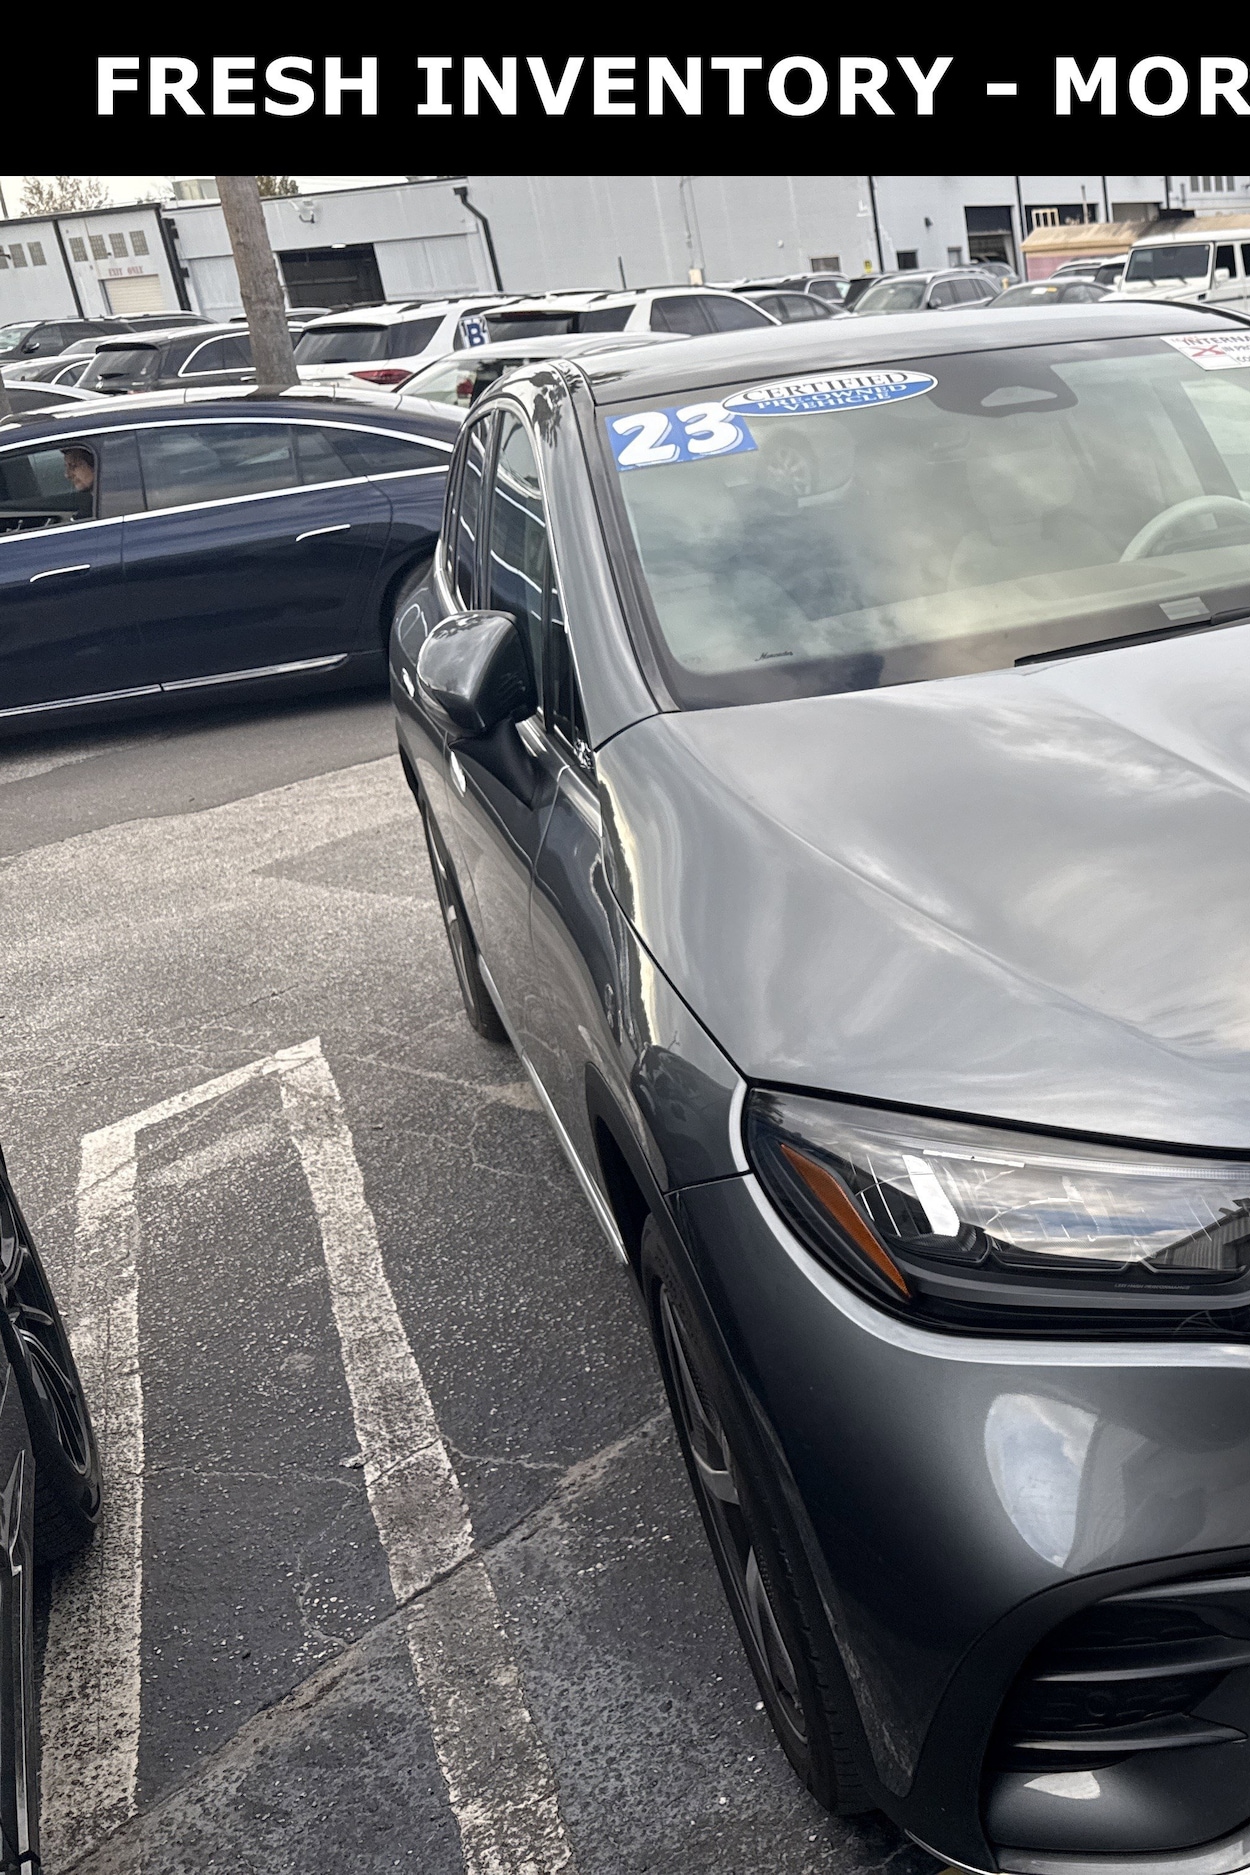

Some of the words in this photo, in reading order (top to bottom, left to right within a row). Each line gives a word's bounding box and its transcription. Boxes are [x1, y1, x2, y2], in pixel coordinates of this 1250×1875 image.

[108, 268, 123, 276] EXIT
[127, 266, 143, 275] ONLY
[742, 372, 908, 401] CERTIFIED
[757, 384, 908, 410] PRE-OWNED
[783, 391, 892, 411] VEHICLE
[612, 402, 744, 467] 23
